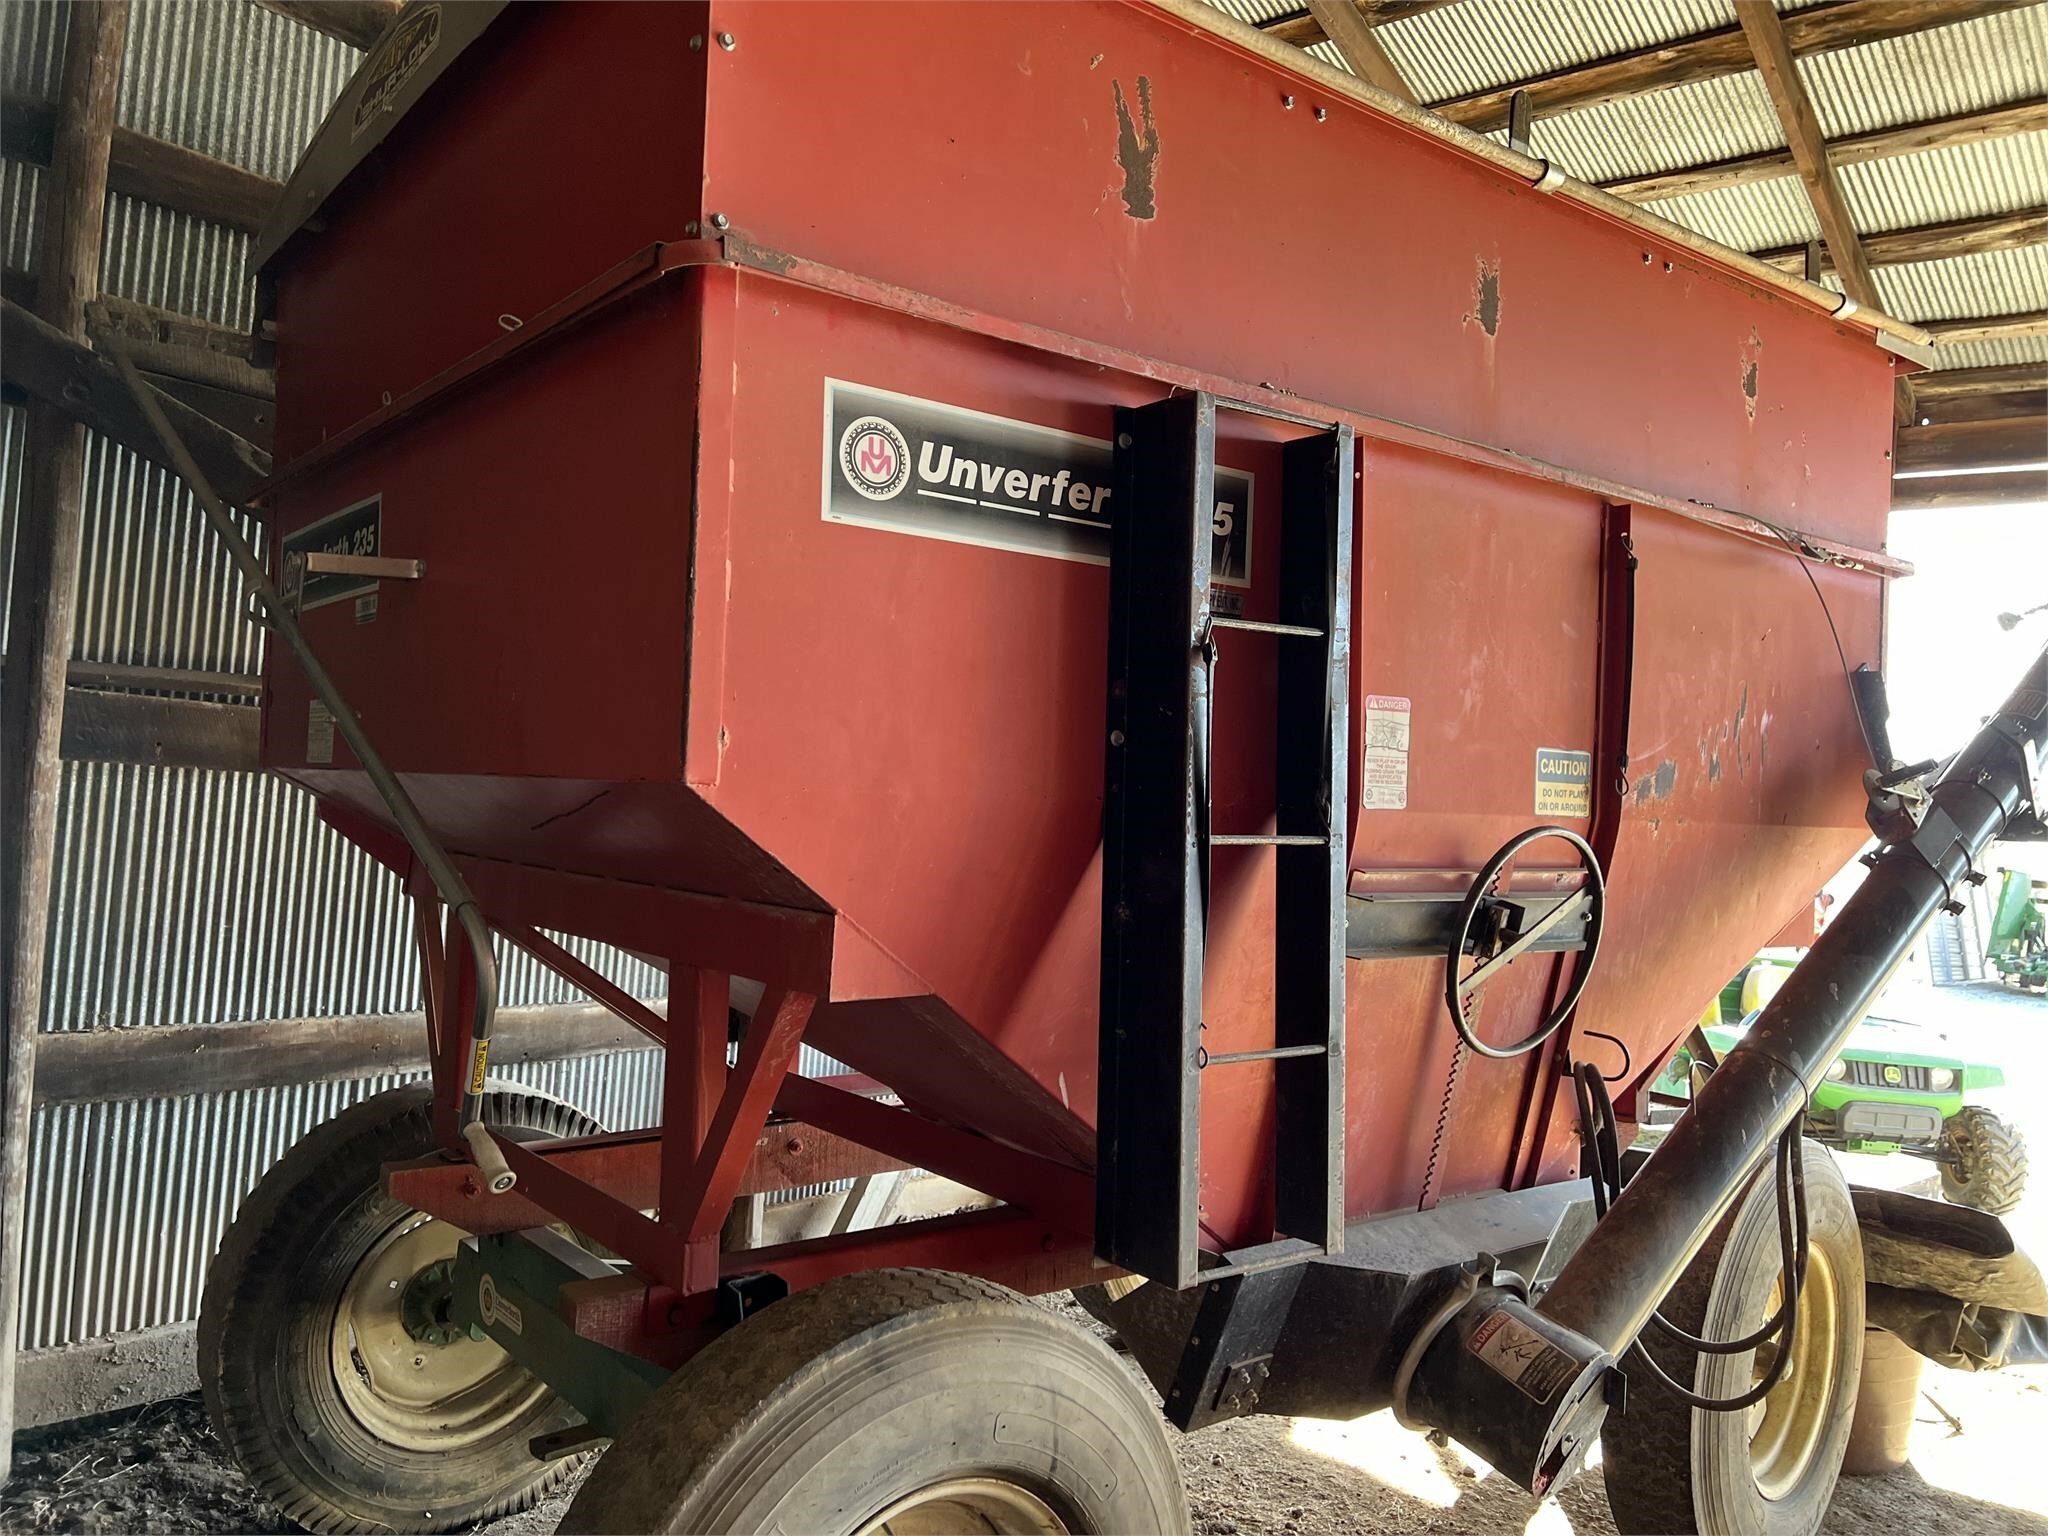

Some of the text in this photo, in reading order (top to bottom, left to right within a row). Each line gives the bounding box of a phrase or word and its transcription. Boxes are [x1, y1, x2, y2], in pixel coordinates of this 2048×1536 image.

[917, 440, 1112, 514] Unverfer
[1378, 700, 1407, 710] DANGER
[1540, 758, 1587, 776] CAUTION
[1543, 788, 1584, 799] DO NOT PLAY
[1538, 802, 1587, 812] ON OR AROUND
[474, 1053, 486, 1082] CAUTION
[1477, 1314, 1511, 1342] DANGER
